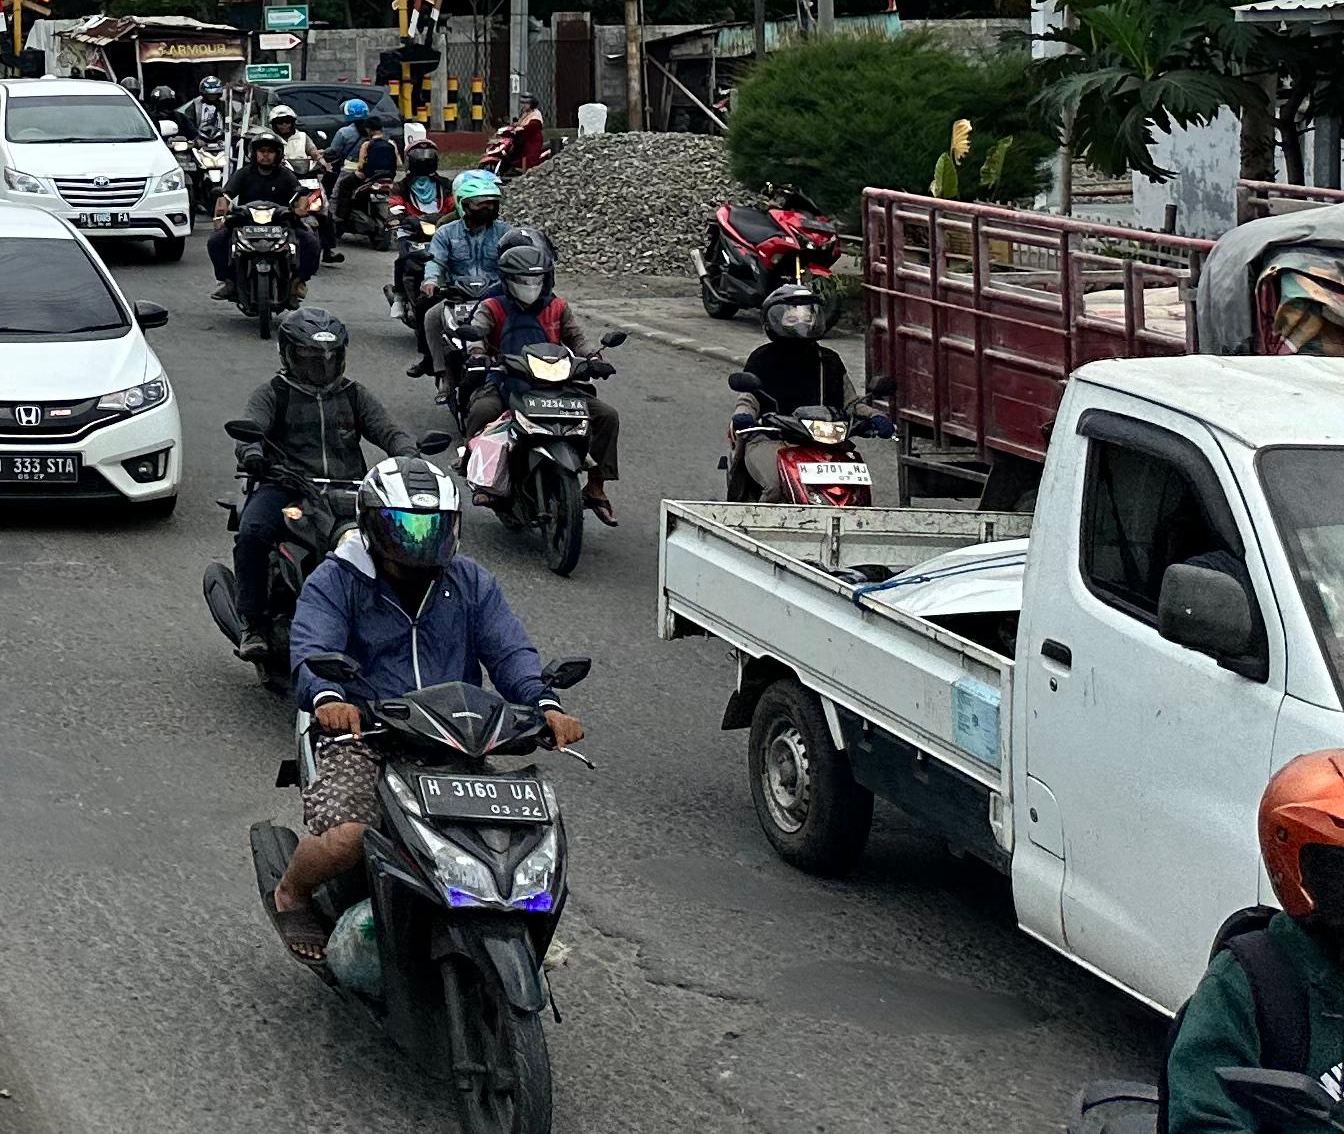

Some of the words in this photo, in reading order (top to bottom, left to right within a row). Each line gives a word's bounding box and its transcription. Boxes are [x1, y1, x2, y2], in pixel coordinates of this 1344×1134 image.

[13, 458, 41, 473] 333
[46, 458, 74, 473] STA
[427, 780, 441, 796] H
[451, 781, 497, 799] 3160
[510, 785, 537, 801] UA
